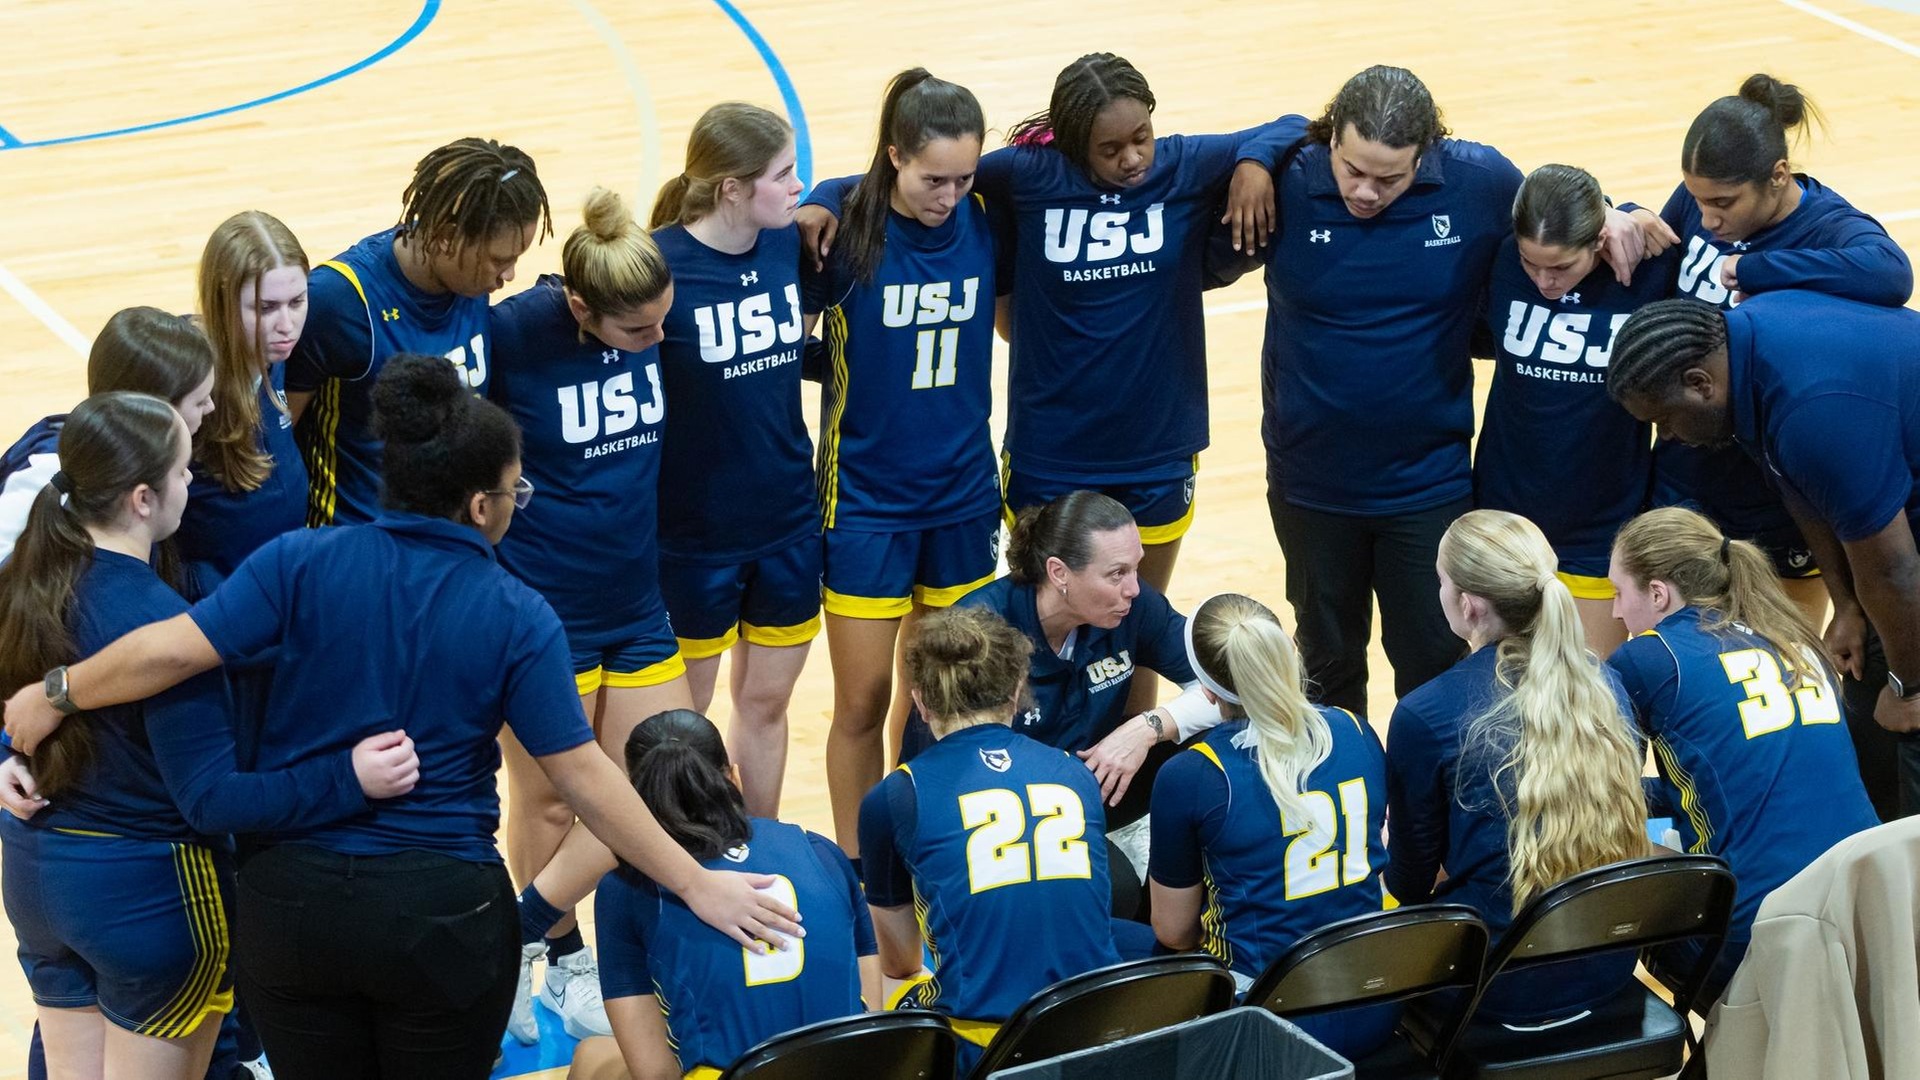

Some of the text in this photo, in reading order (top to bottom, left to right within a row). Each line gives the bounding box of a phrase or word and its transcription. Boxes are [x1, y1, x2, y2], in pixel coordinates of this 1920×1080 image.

[1044, 202, 1164, 263] USJ
[1424, 235, 1461, 248] BASKETBALL
[1063, 260, 1156, 281] BASKETBALL
[1678, 235, 1742, 309] US
[694, 283, 802, 363] USJ
[883, 277, 980, 328] USJ
[444, 333, 486, 387] SJ
[911, 327, 960, 390] 11
[1503, 300, 1632, 367] USJ
[723, 349, 798, 380] BASKETBALL
[1516, 363, 1604, 383] BASKETBALL
[557, 363, 664, 444] USJ
[584, 431, 658, 459] BASKETBALL
[1086, 650, 1132, 684] USJ
[1718, 642, 1840, 740] 33
[958, 783, 1092, 895] 22
[1280, 776, 1371, 901] 21
